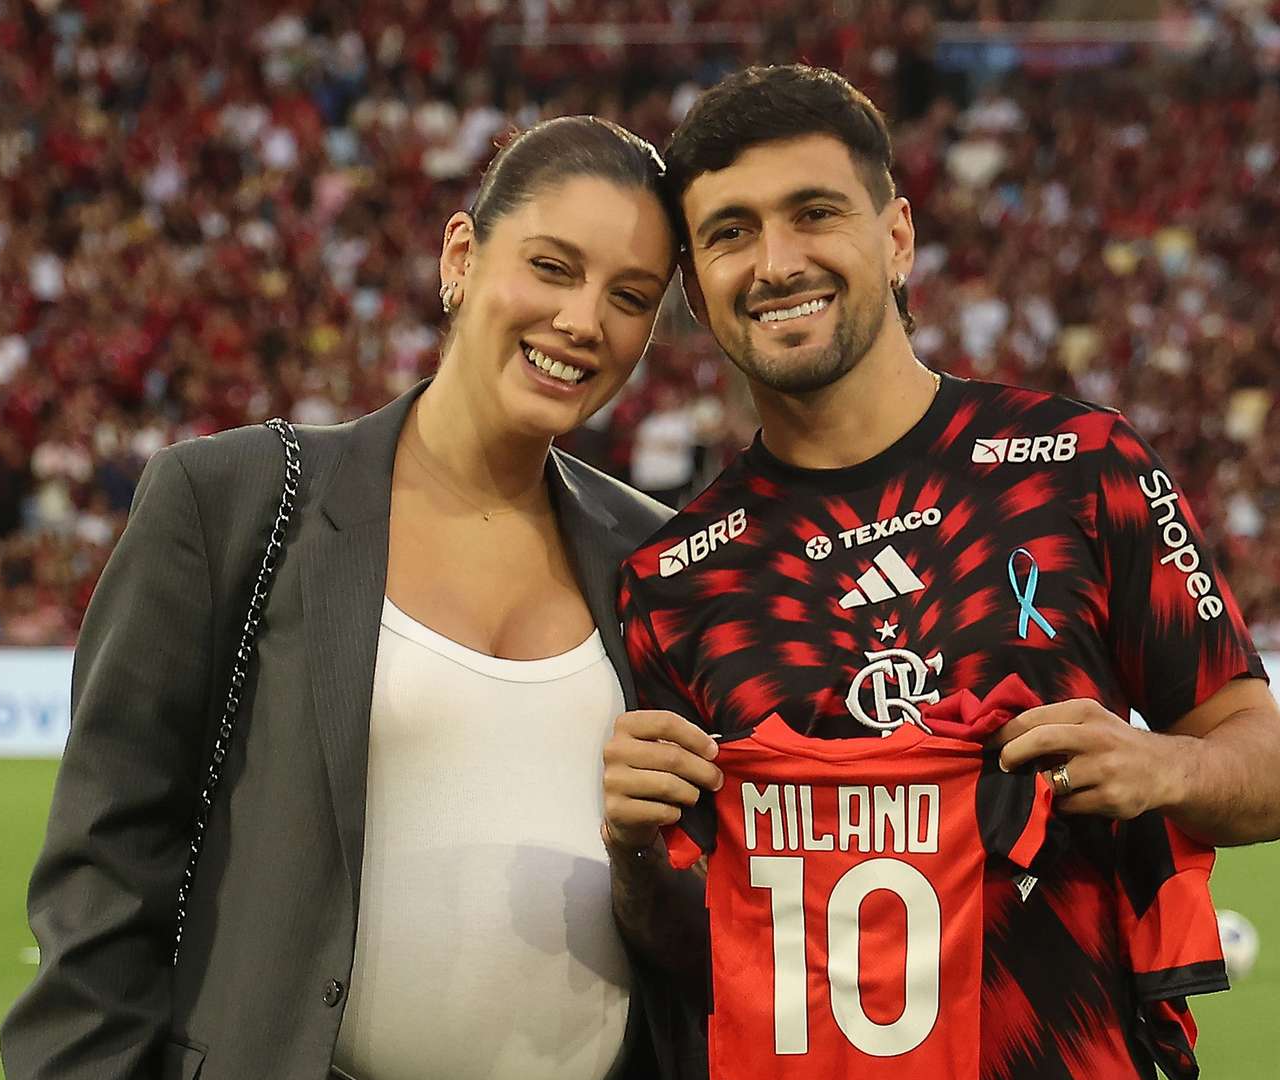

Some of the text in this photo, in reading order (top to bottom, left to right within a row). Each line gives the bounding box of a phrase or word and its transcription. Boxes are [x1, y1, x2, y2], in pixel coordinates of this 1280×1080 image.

[1007, 433, 1078, 463] BRB
[689, 508, 748, 563] BRB
[838, 508, 942, 549] TEXACO
[1138, 469, 1223, 621] Shopee
[741, 782, 940, 853] MILANO
[749, 856, 941, 1058] 10
